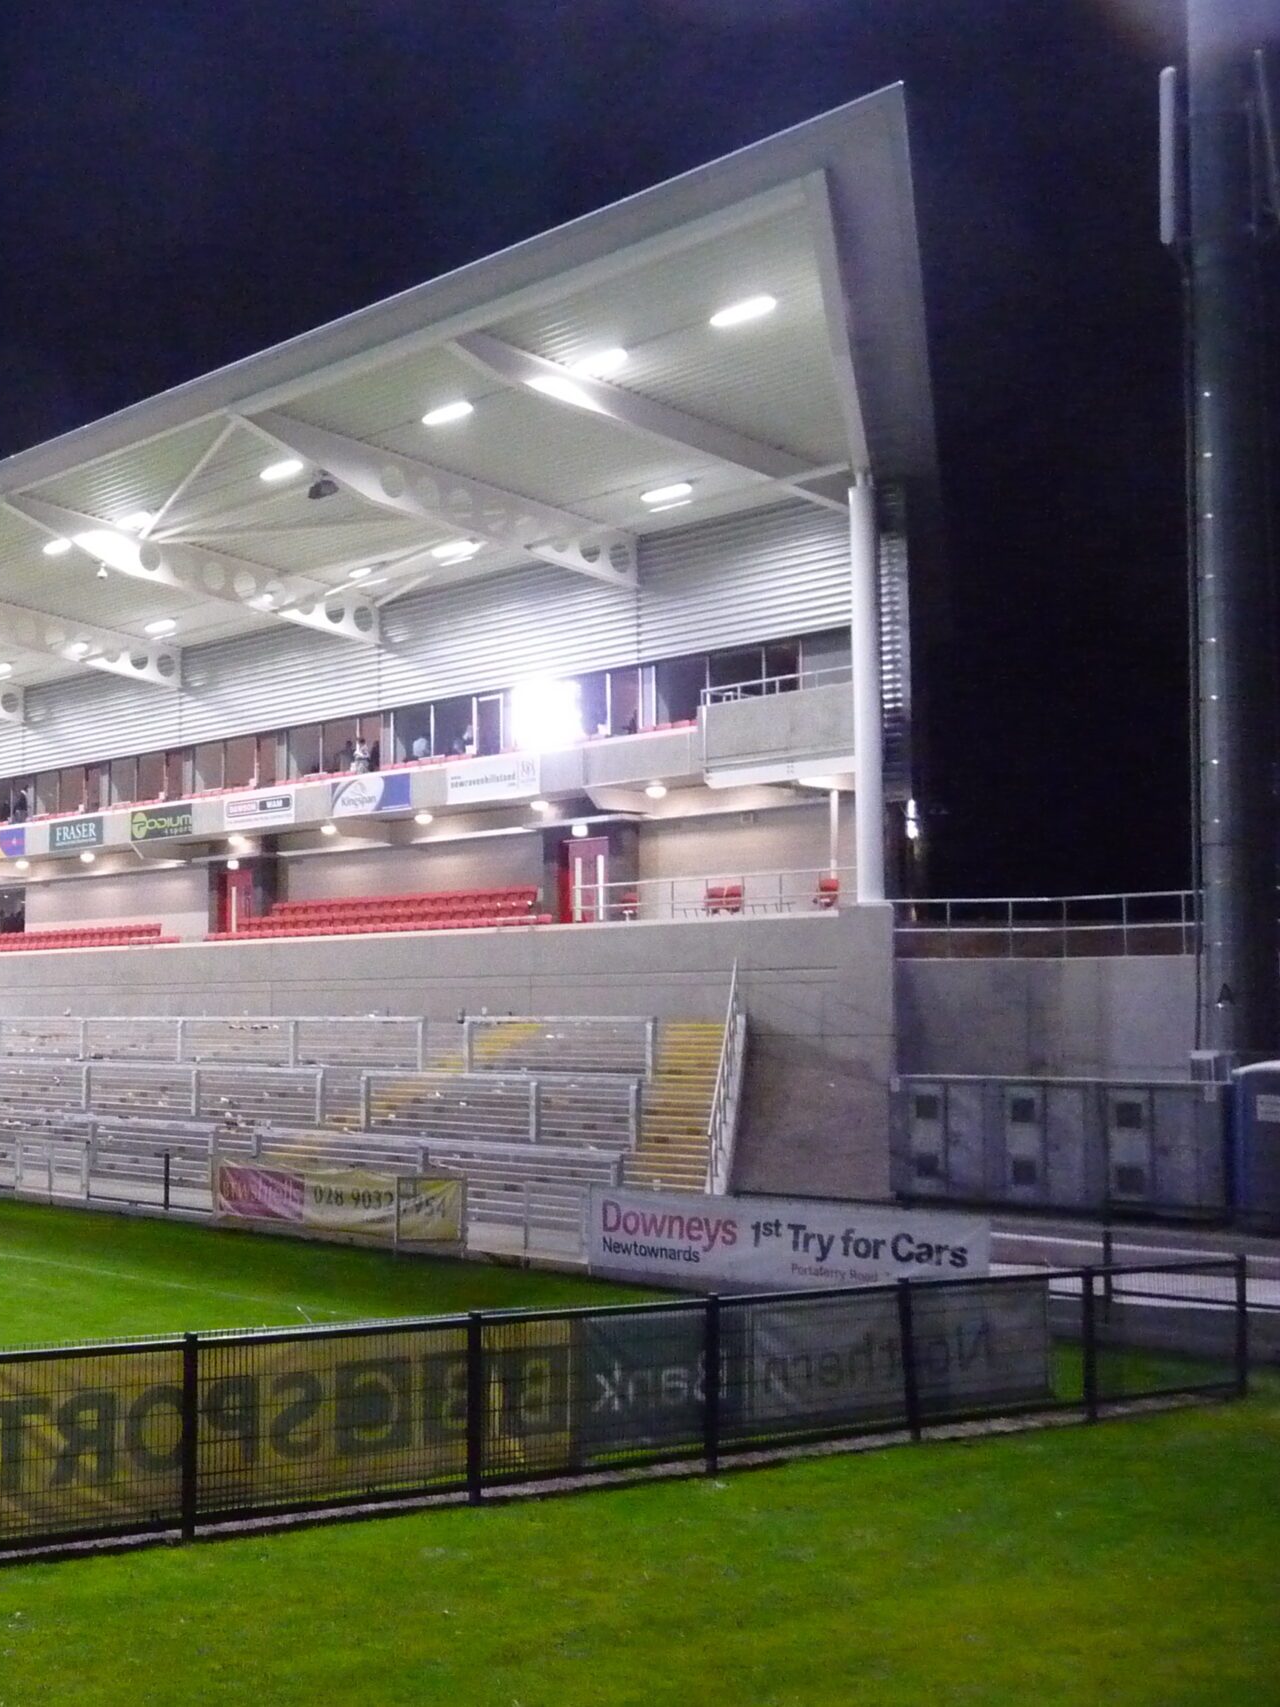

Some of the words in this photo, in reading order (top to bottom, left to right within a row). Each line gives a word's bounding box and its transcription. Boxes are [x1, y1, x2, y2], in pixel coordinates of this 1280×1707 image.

[56, 822, 97, 841] FRASER
[314, 1184, 344, 1206] 028
[602, 1200, 738, 1252] Downeys
[751, 1219, 782, 1247] 1st
[787, 1223, 835, 1262] Try
[841, 1228, 886, 1259] for
[891, 1233, 968, 1268] Cars
[602, 1236, 700, 1263] Newtownards
[791, 1263, 846, 1281] Portaferry
